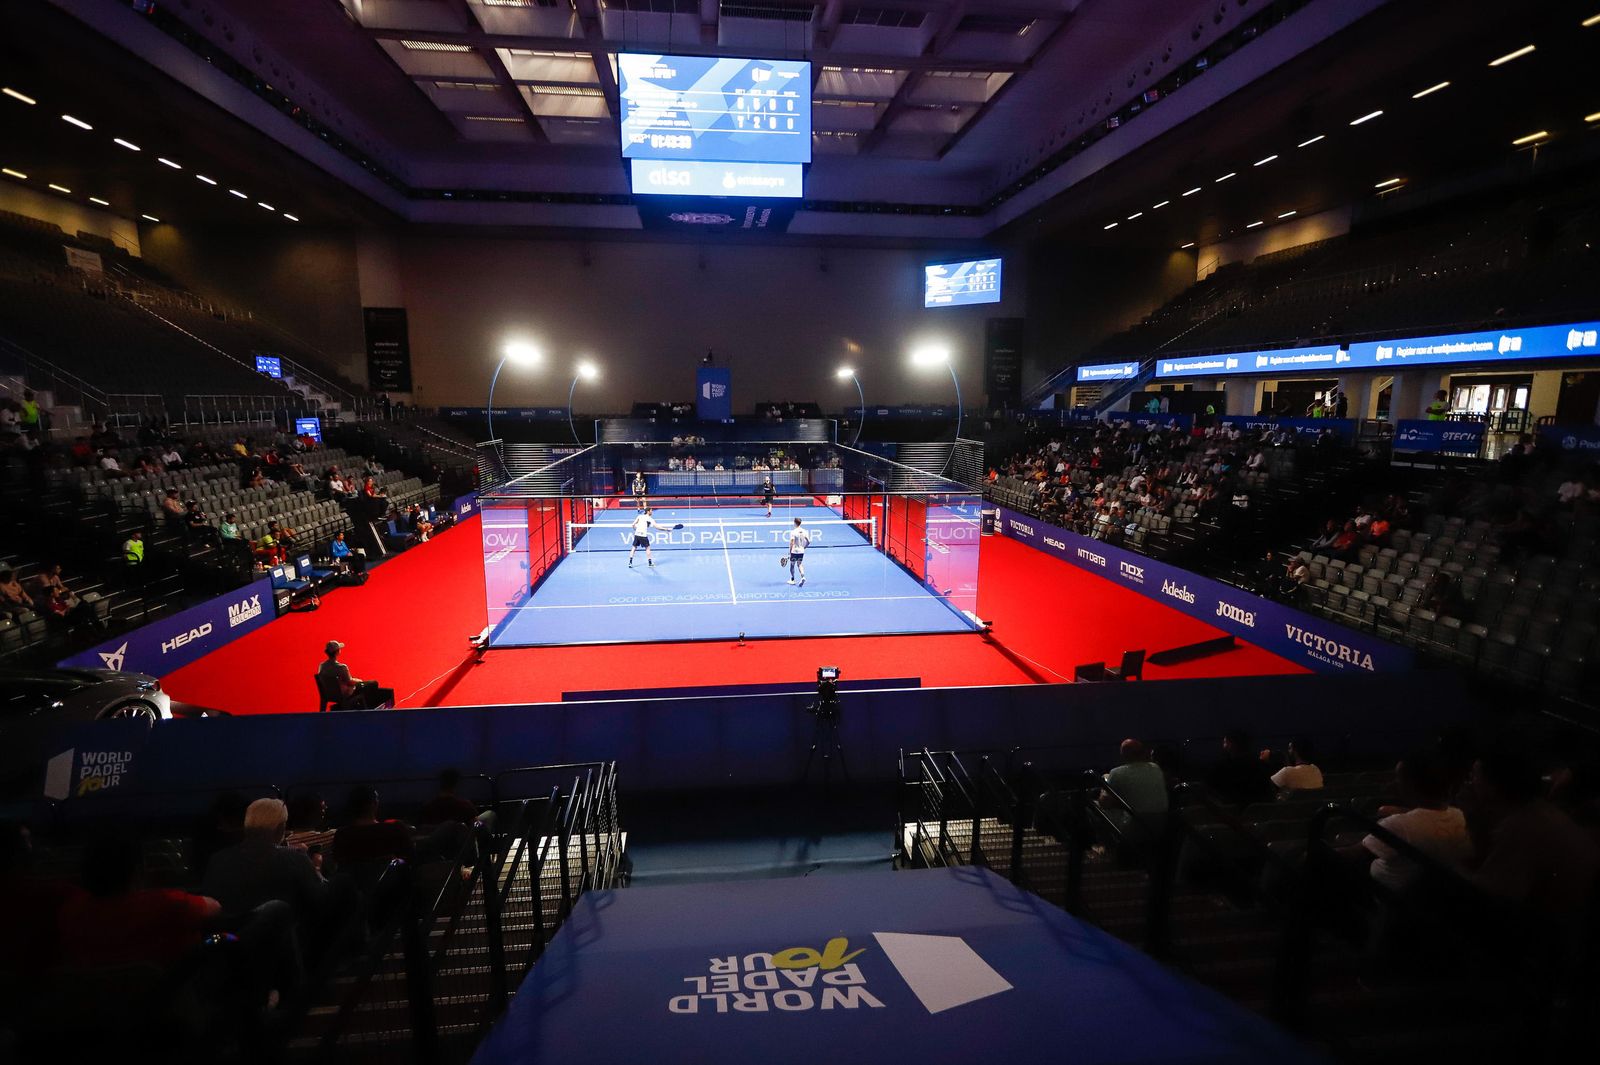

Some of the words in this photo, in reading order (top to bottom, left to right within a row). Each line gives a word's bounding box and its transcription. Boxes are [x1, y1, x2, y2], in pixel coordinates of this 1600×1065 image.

[649, 168, 690, 186] alsa
[700, 530, 765, 544] PADEL
[769, 530, 823, 543] TOR
[1010, 520, 1034, 536] VICTORIA
[1043, 536, 1066, 550] HEAD
[1077, 548, 1090, 560] NTT
[1161, 579, 1195, 604] Adeslas
[228, 595, 260, 618] MAX
[162, 622, 213, 654] HEAD
[1286, 624, 1375, 671] VICTORIA
[82, 752, 132, 766] WORLD
[80, 763, 128, 779] PADEL
[683, 963, 867, 994] PADEL
[668, 985, 886, 1014] WORLD
